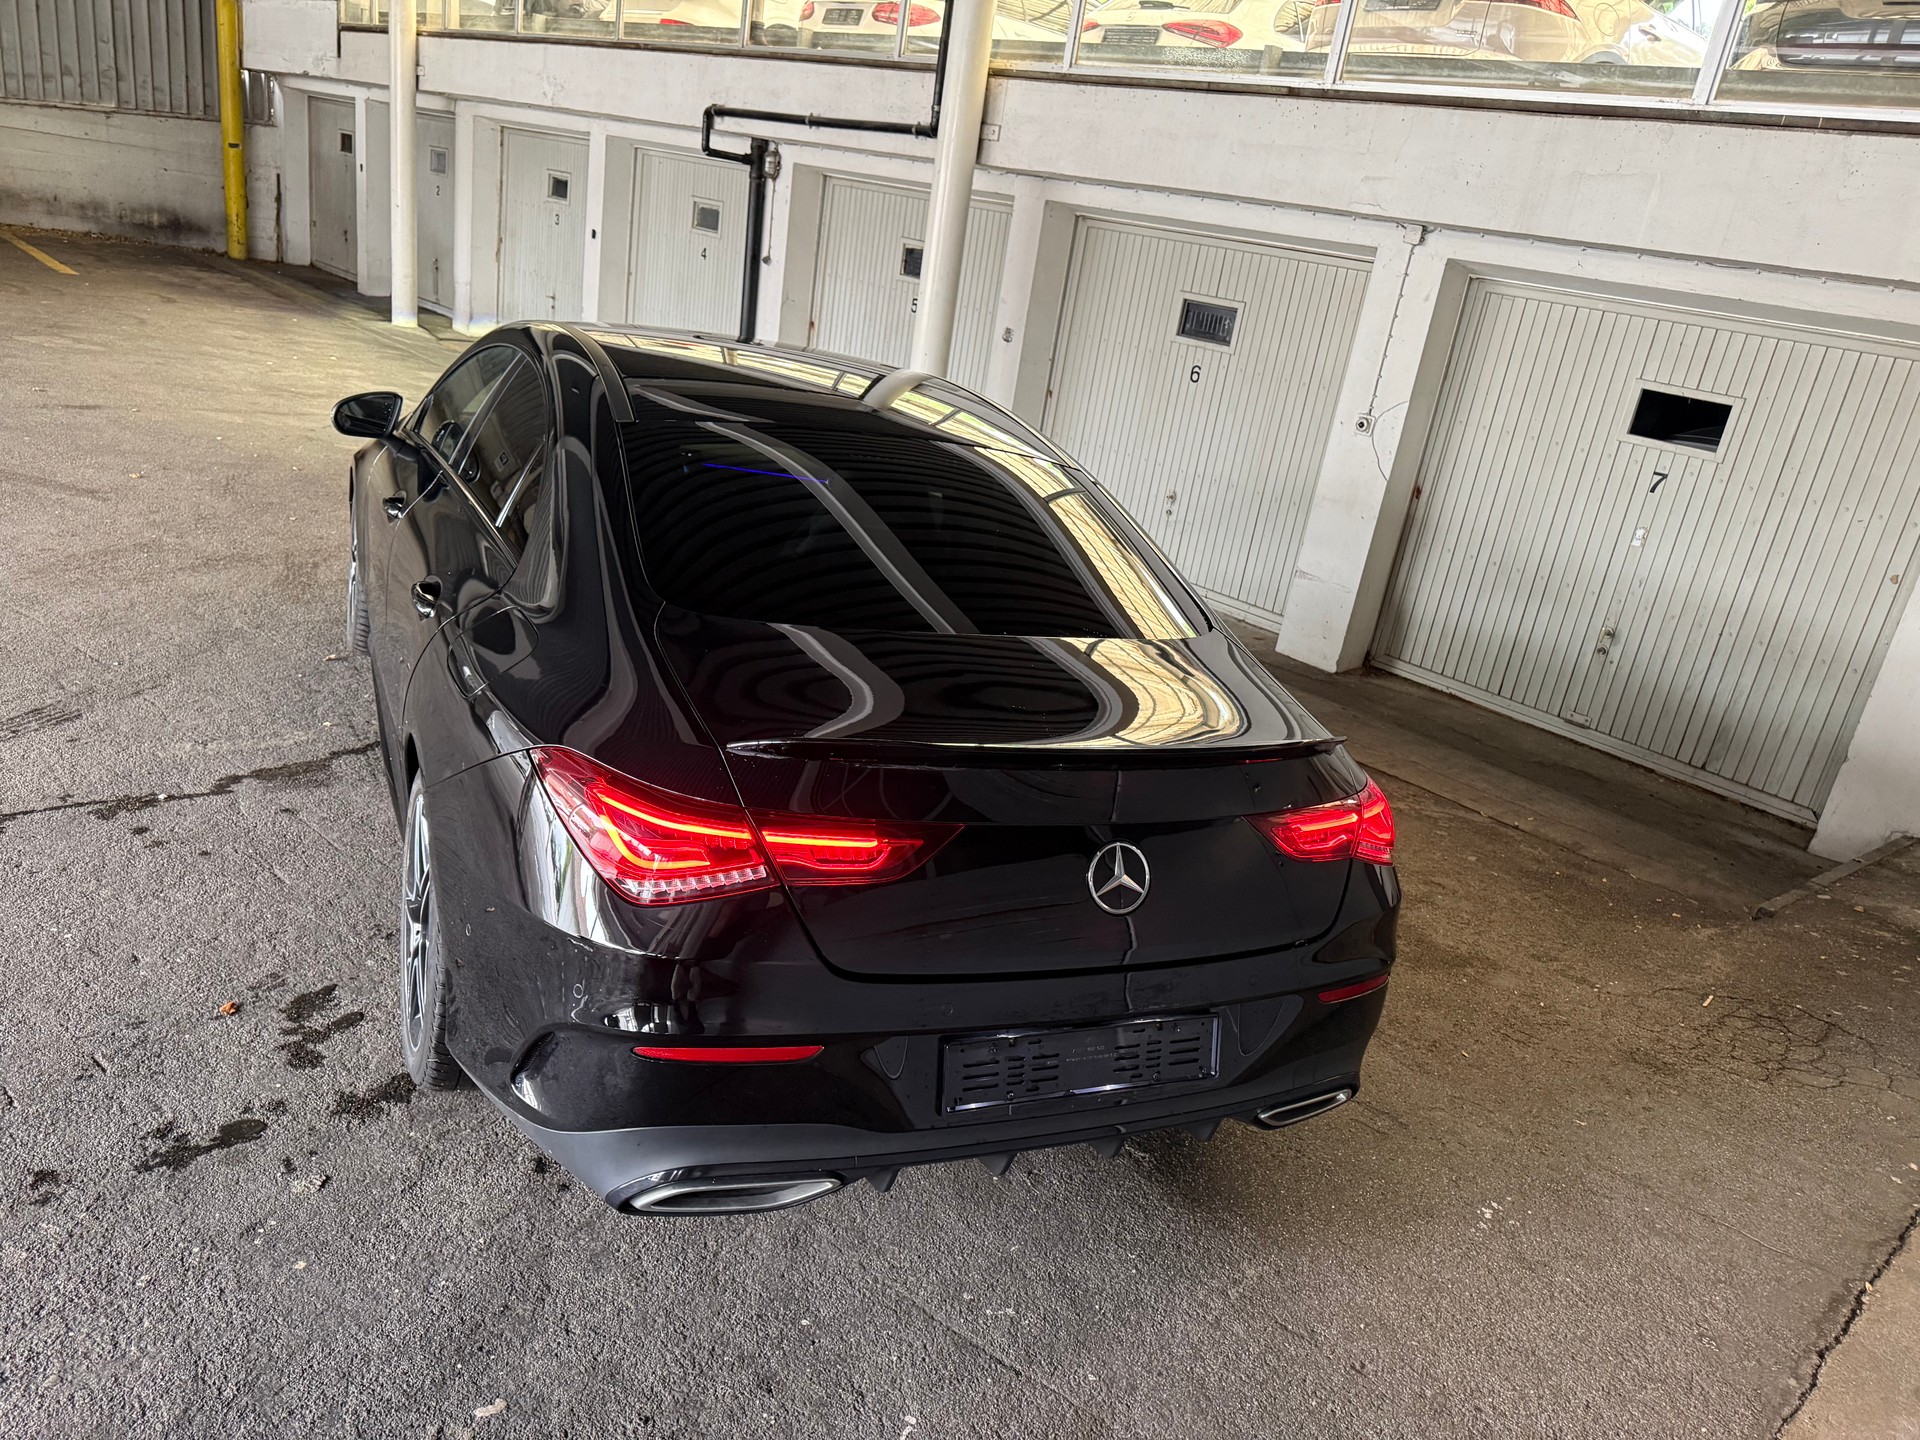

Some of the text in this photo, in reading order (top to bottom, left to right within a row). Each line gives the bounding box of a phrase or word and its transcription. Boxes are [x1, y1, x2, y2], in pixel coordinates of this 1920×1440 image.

[436, 186, 442, 196] 2
[555, 214, 561, 225] 3
[701, 248, 708, 260] 4
[911, 298, 918, 313] 5
[1190, 365, 1202, 383] 6
[1649, 471, 1668, 494] 7
